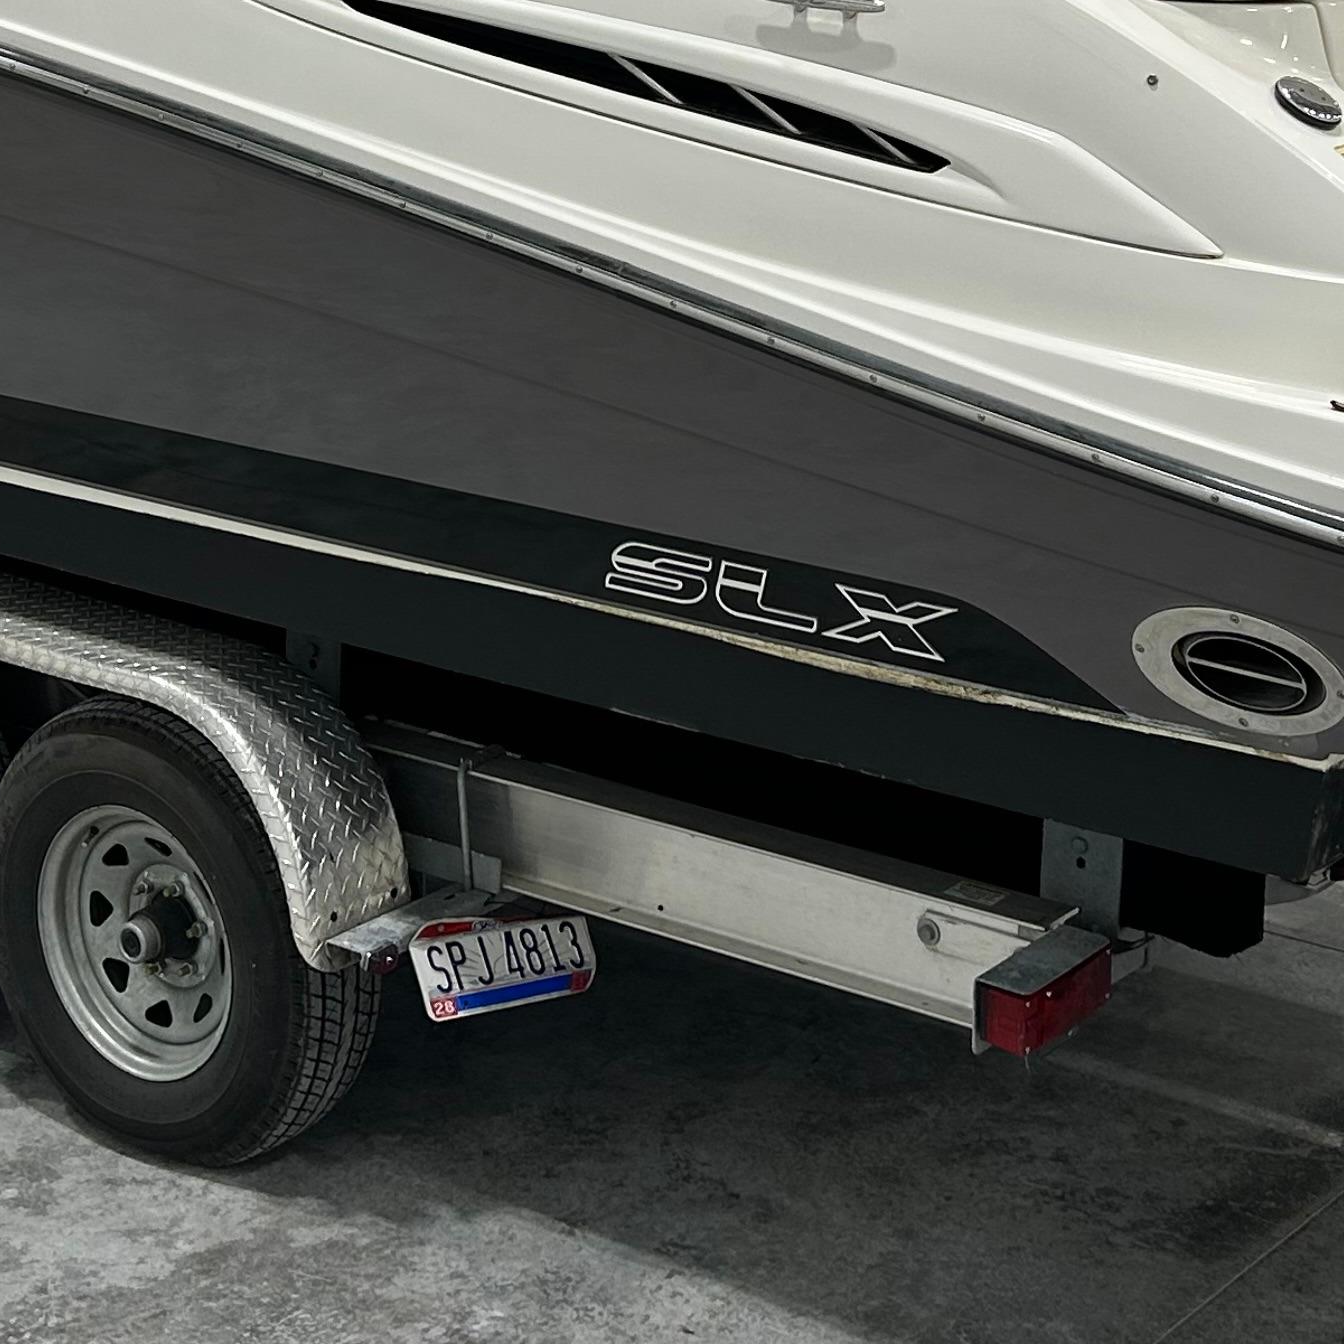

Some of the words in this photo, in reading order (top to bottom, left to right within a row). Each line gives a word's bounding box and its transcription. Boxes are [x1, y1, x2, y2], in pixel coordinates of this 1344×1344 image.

[605, 541, 959, 663] SLX
[426, 936, 495, 994] SPJ
[504, 921, 585, 979] 4813
